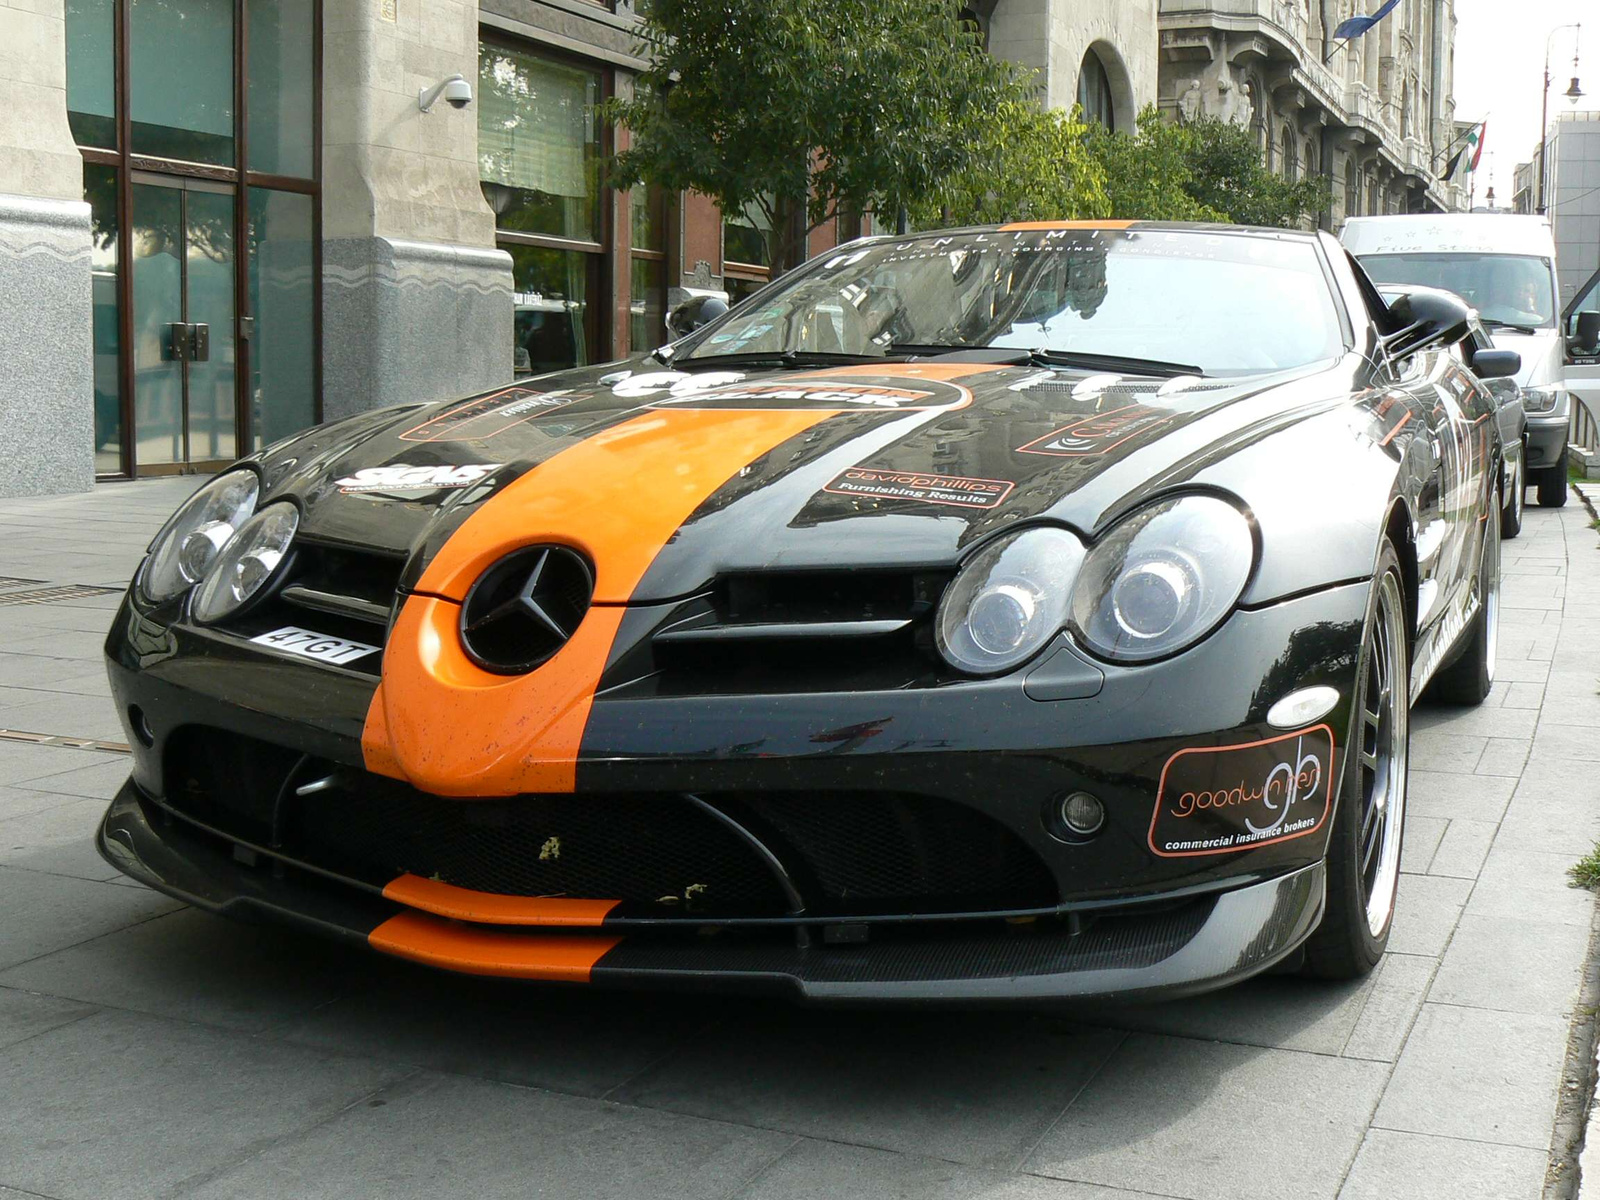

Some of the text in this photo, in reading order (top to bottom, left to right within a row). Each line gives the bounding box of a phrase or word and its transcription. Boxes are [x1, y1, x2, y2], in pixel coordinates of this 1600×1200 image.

[1376, 245, 1422, 253] Five
[837, 482, 988, 504] Furnishing Results
[845, 471, 1002, 493] davidphillips
[267, 631, 369, 658] 47GT
[1165, 817, 1315, 850] commercial insurance brokers
